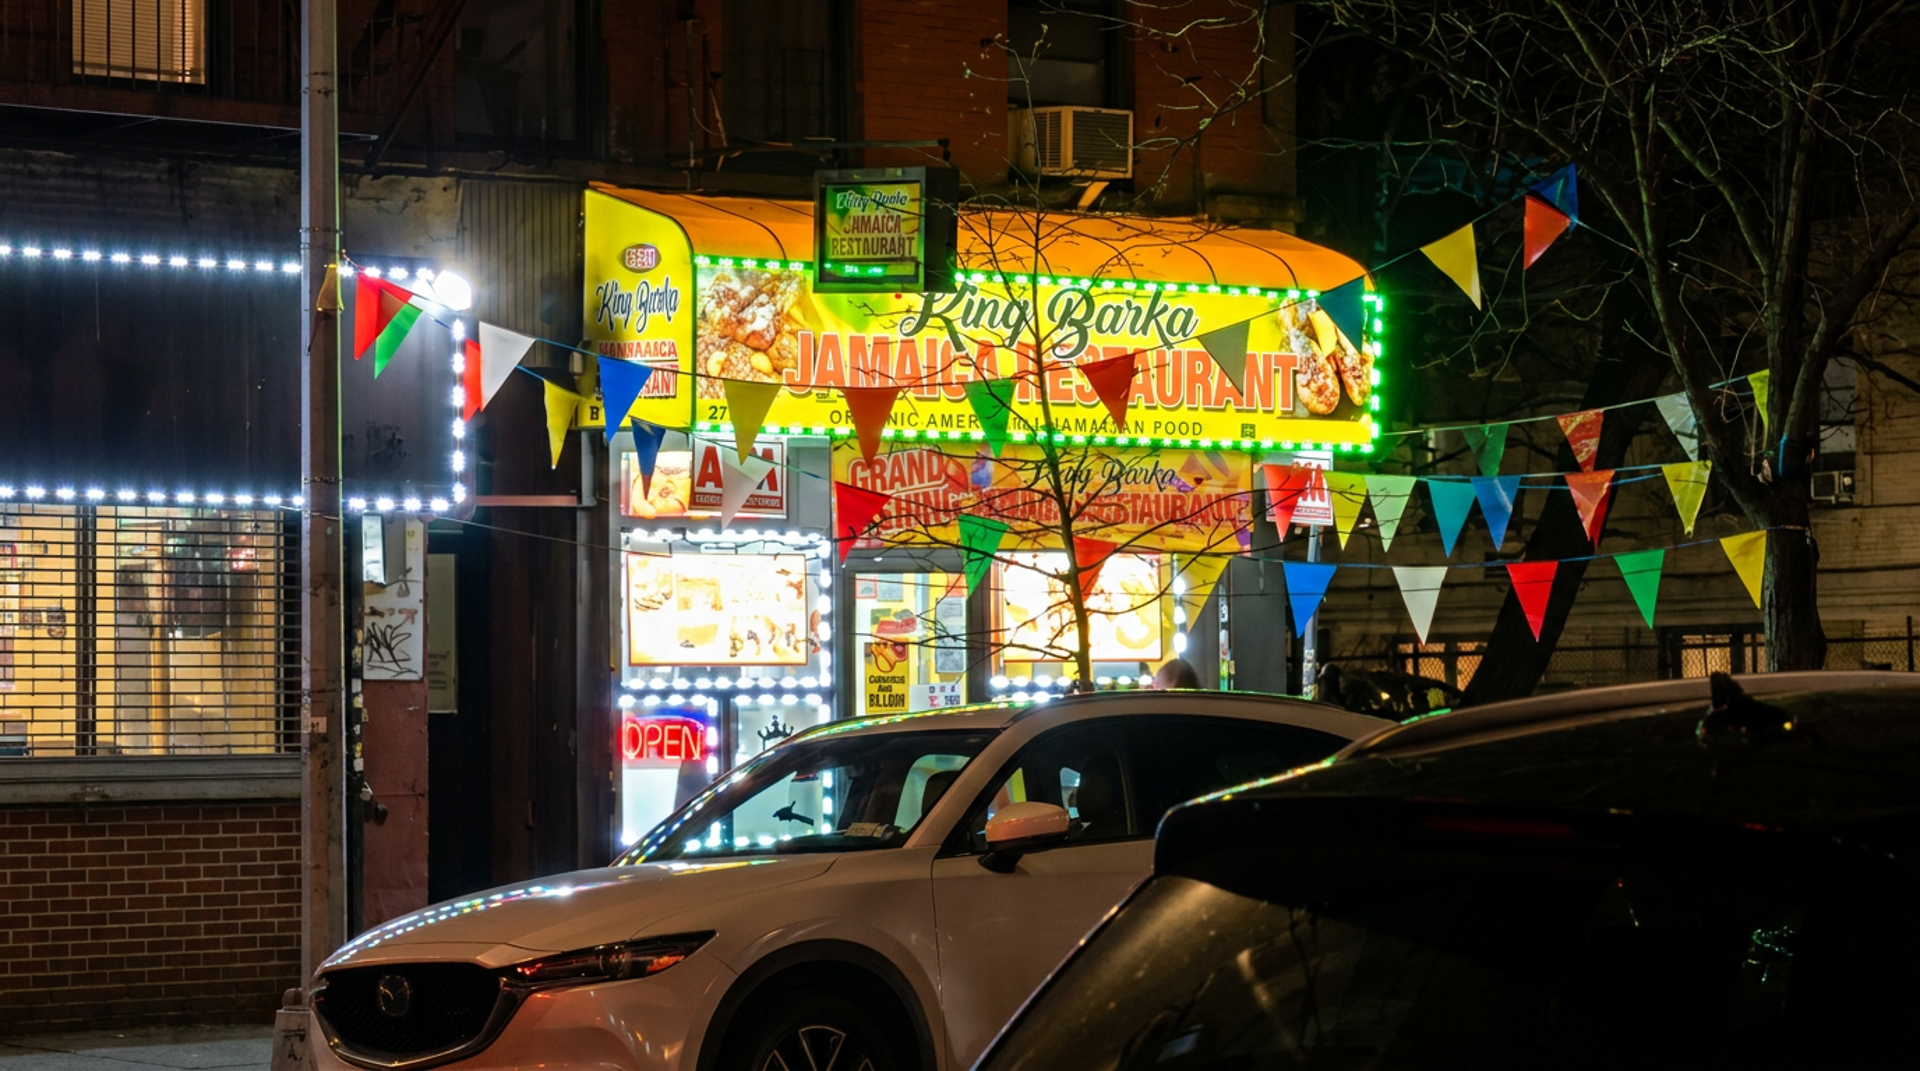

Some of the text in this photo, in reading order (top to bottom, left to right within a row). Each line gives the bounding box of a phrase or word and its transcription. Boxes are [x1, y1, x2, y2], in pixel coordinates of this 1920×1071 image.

[900, 281, 1199, 360] King Barka
[783, 330, 1300, 412] JAMAICA RESAURANT
[829, 410, 920, 428] ORNIC
[850, 450, 946, 493] GRAND
[622, 722, 702, 760] OPEN
